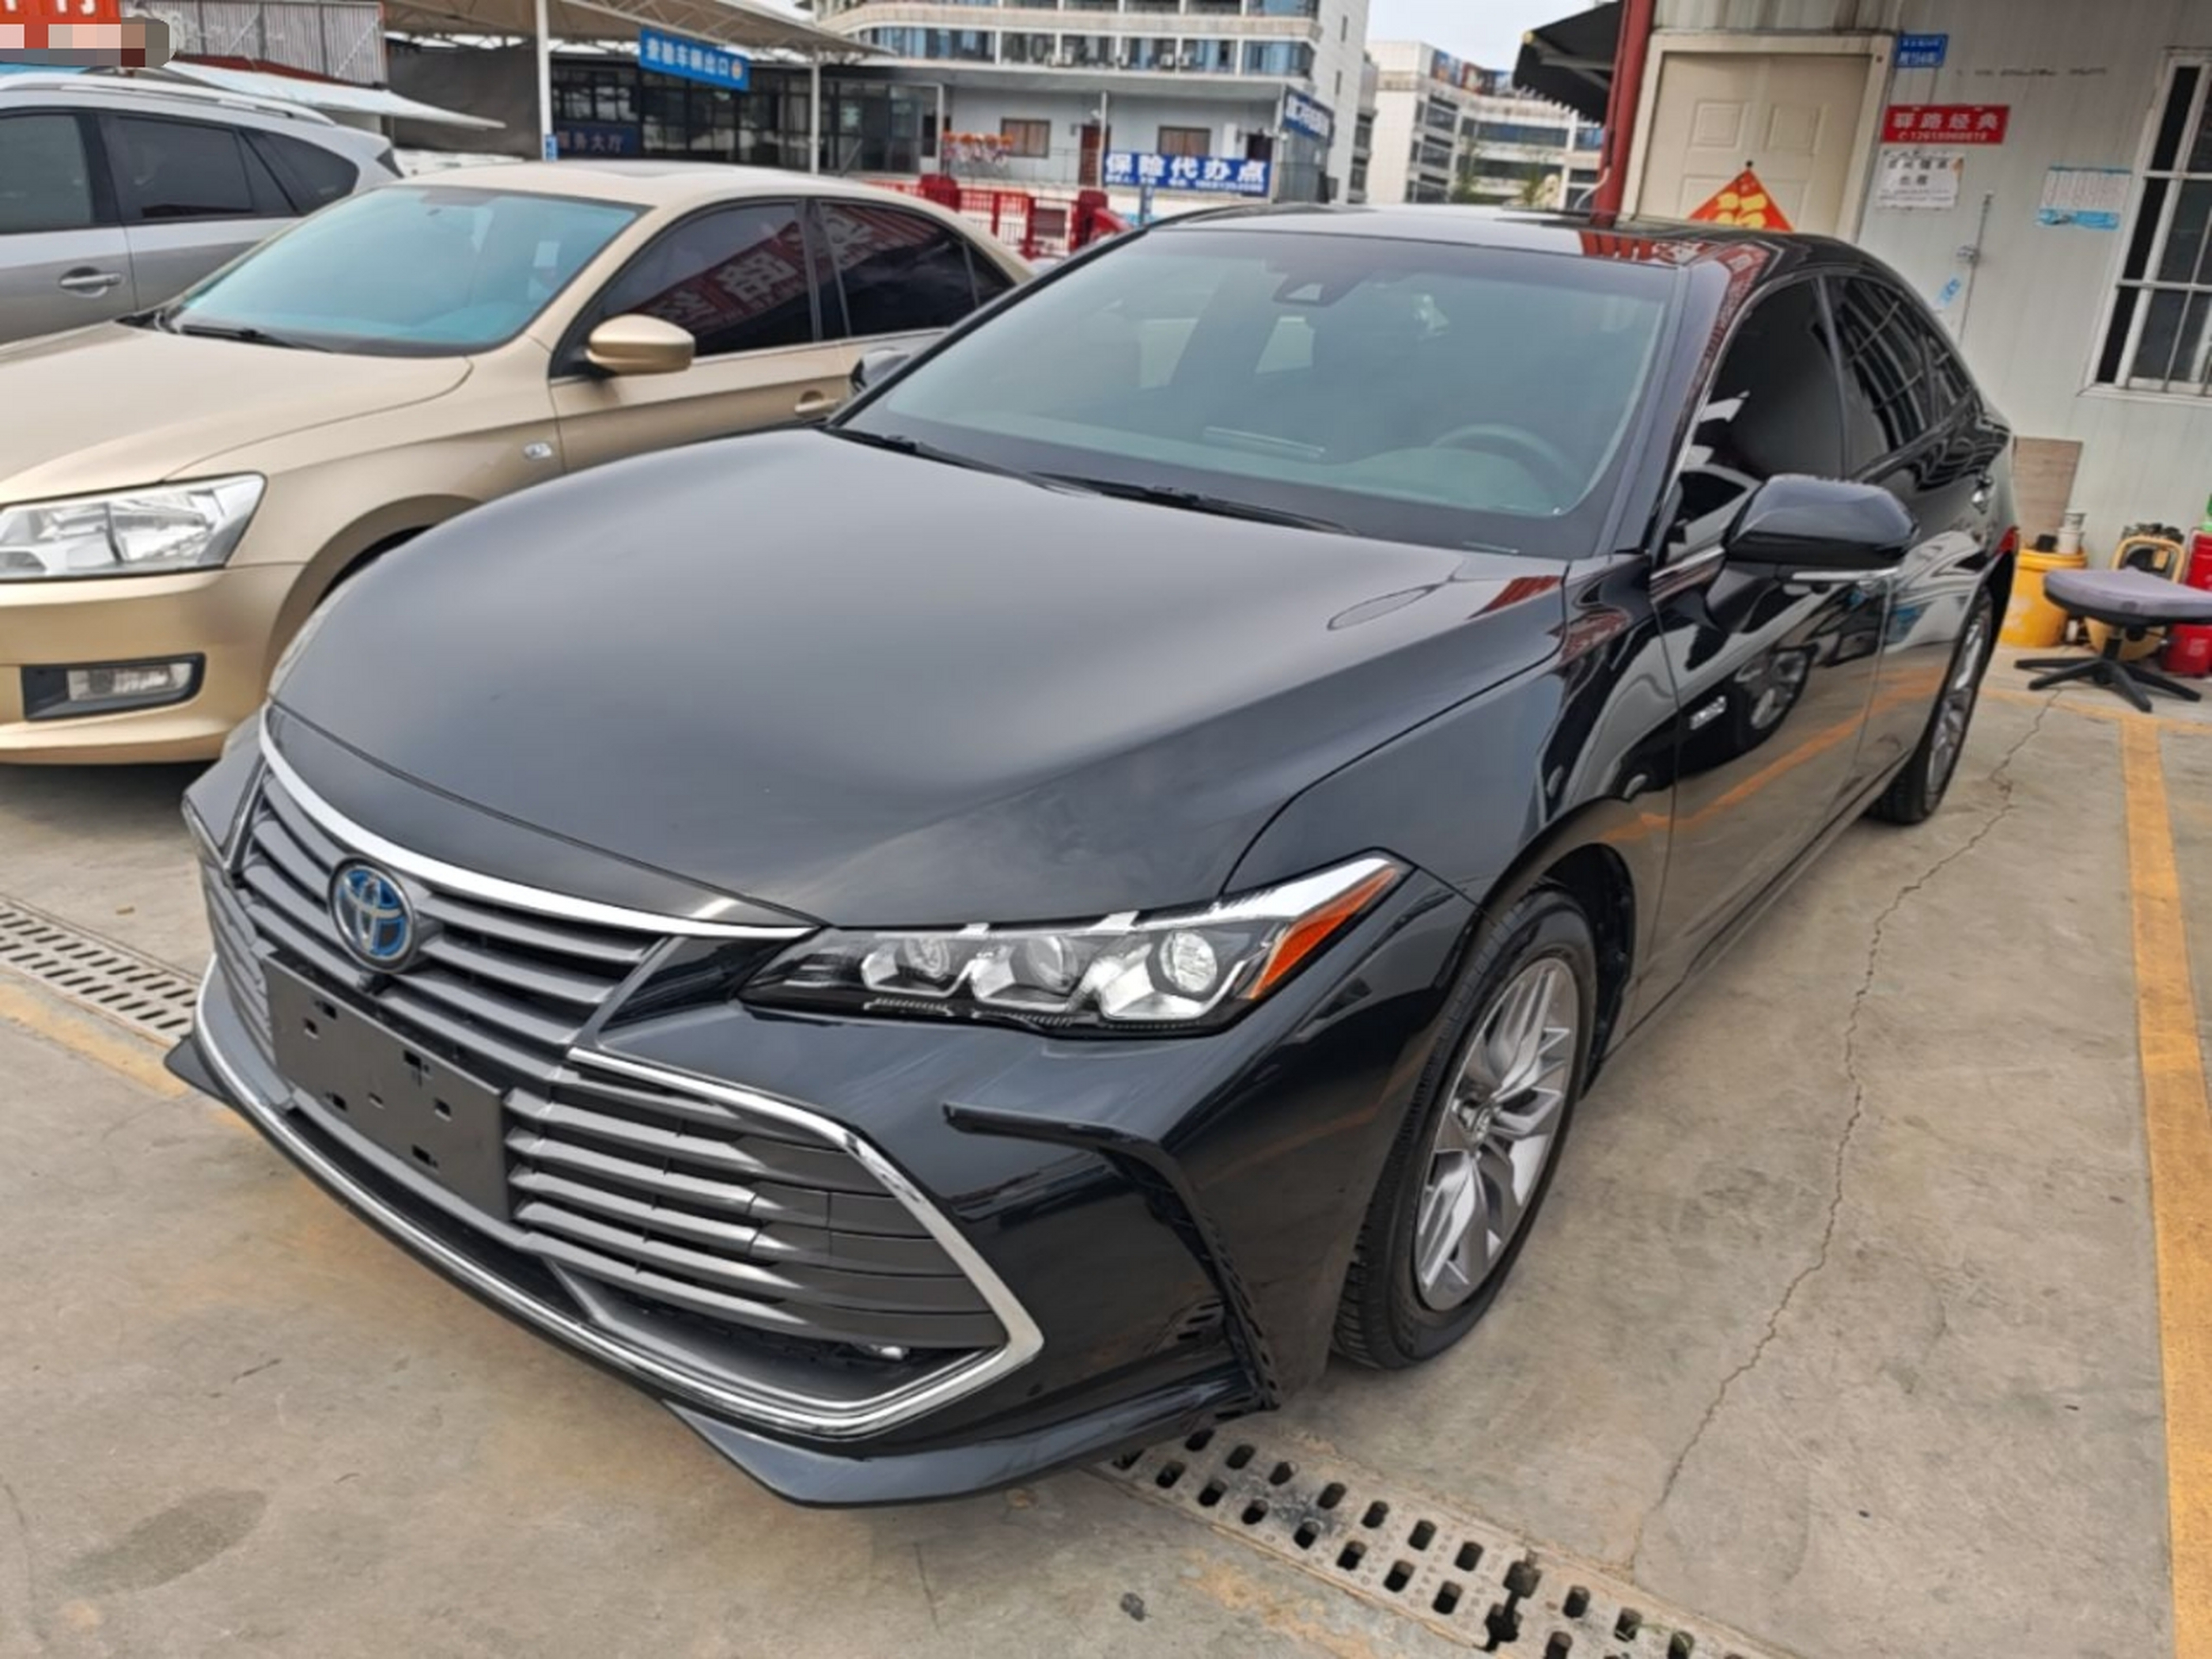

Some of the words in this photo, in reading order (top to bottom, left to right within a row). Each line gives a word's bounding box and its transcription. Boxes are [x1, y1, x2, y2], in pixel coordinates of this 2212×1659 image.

[1106, 153, 1267, 183] 保险代办点
